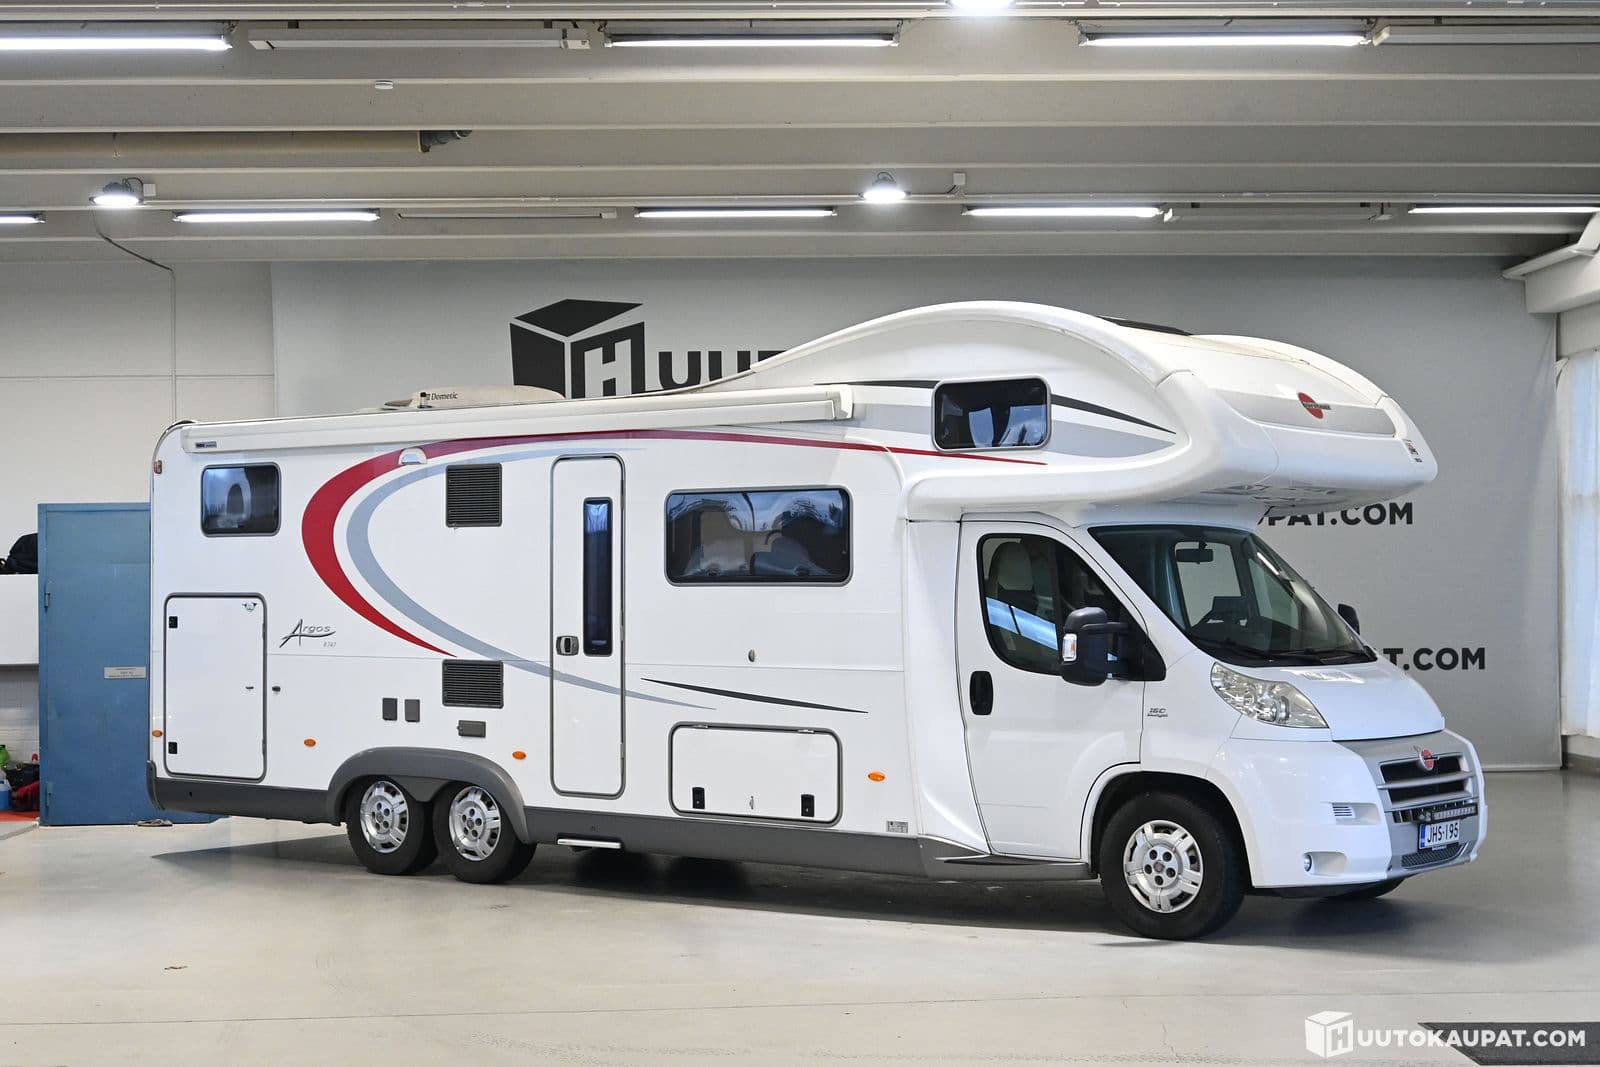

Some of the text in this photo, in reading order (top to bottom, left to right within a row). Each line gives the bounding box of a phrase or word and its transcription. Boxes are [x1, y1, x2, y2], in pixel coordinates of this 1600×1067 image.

[431, 391, 458, 401] Dometic
[279, 618, 332, 648] Argos
[1427, 822, 1459, 843] JHS-195
